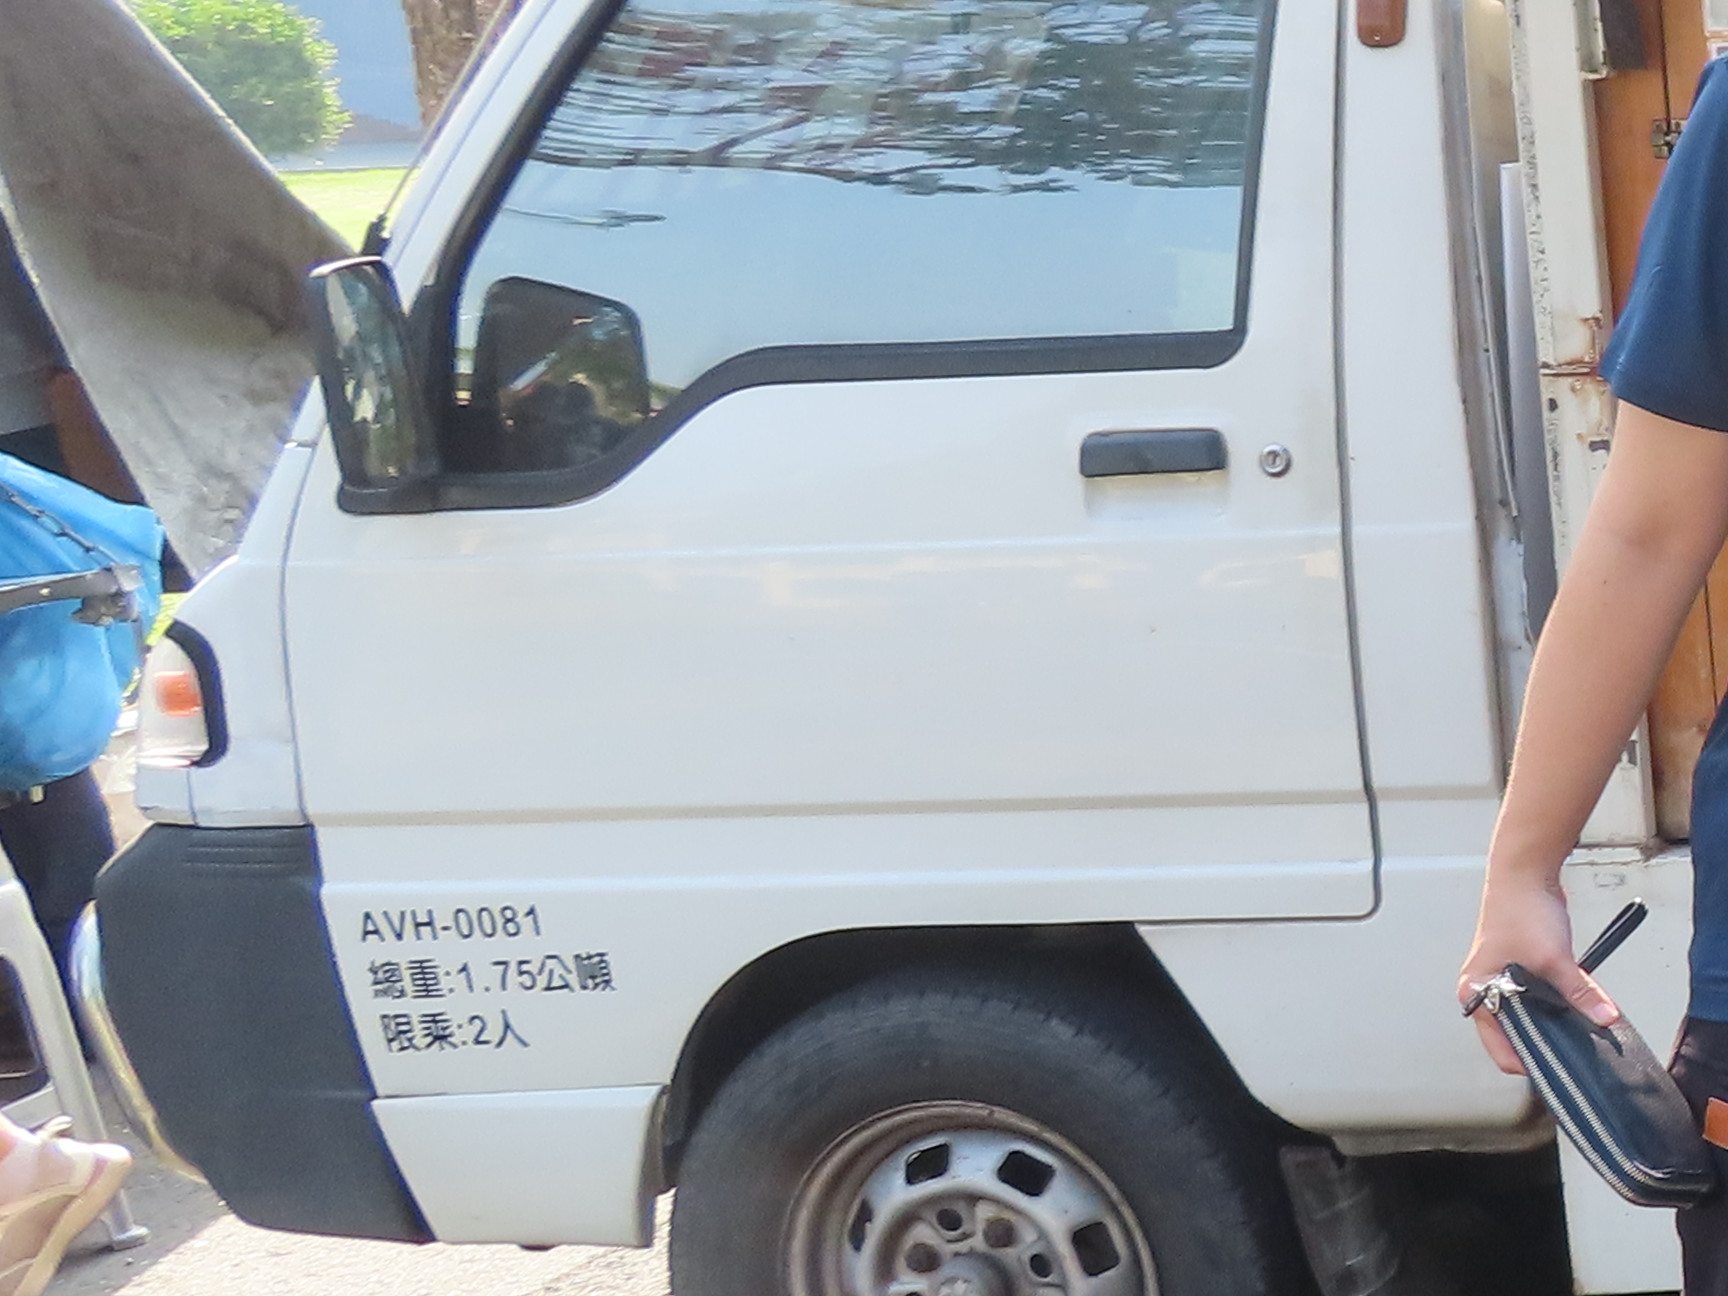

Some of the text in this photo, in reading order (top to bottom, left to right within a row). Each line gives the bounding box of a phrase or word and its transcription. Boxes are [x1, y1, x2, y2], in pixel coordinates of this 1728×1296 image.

[361, 904, 542, 942] AVH-0081
[380, 1009, 531, 1053] 限乘:2人
